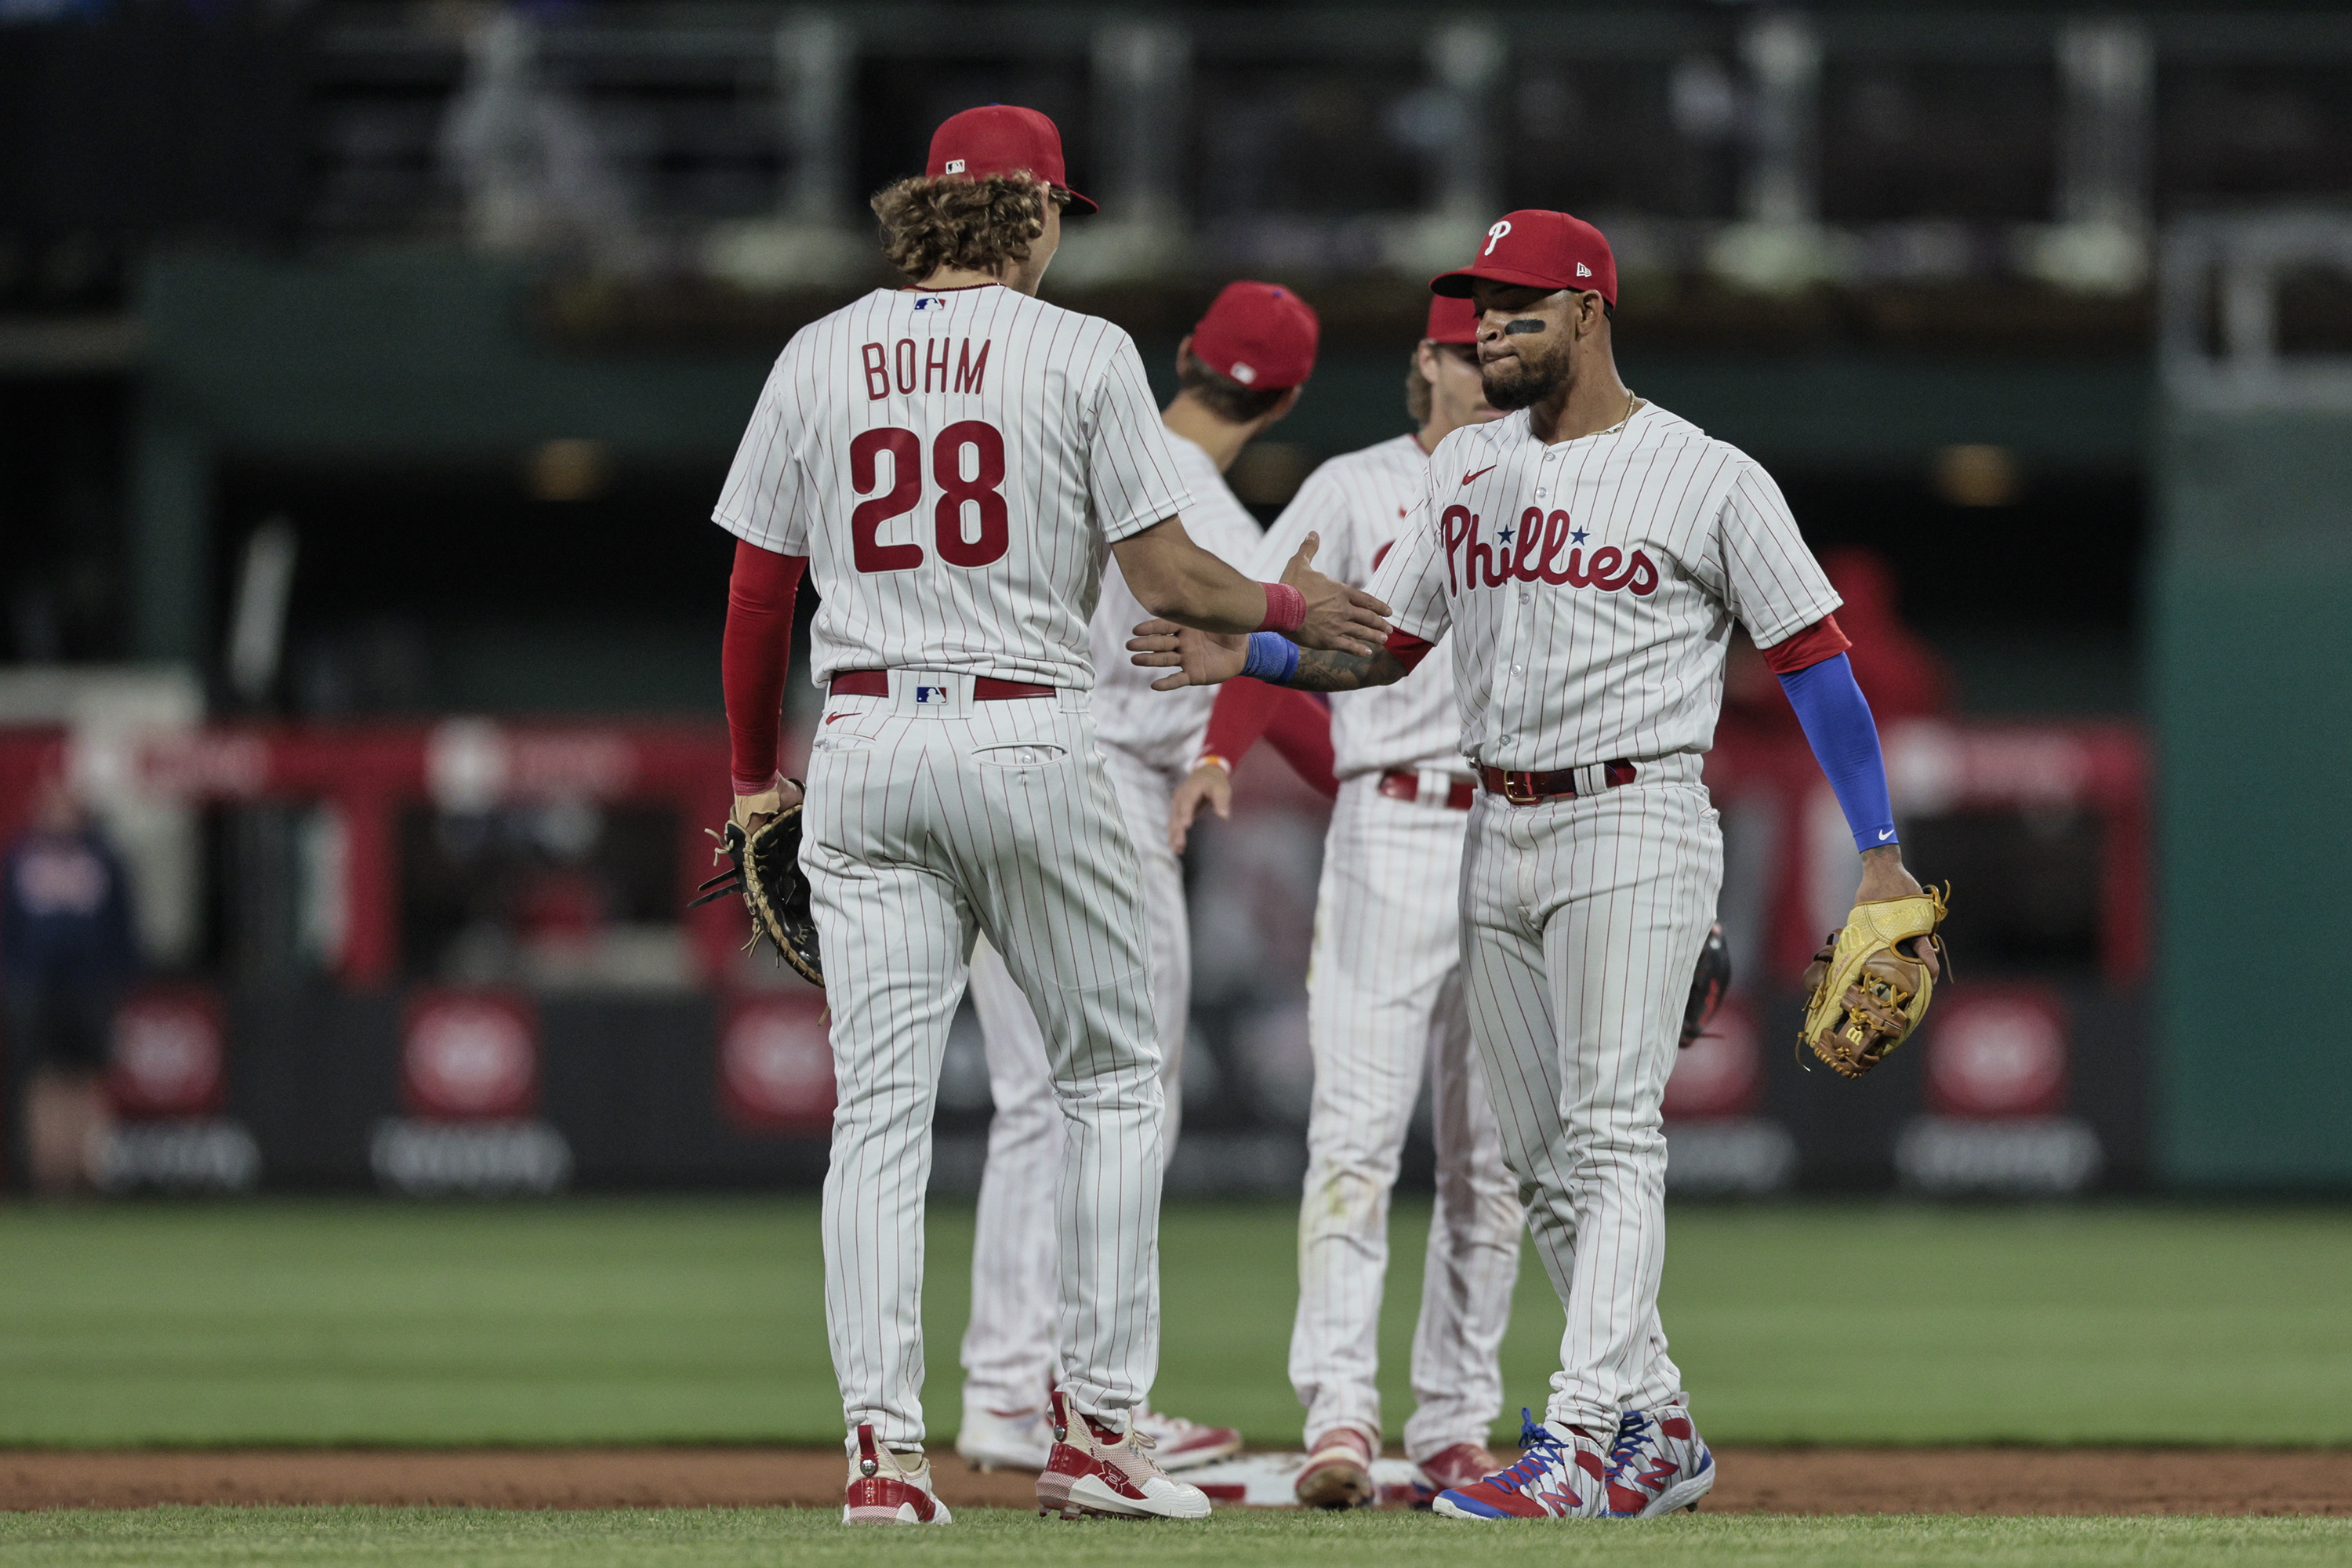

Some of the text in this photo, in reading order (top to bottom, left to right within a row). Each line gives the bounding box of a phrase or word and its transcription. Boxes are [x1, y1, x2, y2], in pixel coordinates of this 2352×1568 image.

[1484, 220, 1512, 256] P
[862, 337, 991, 401] BOHM
[849, 419, 1010, 574] 28
[1441, 504, 1659, 598] Phillies
